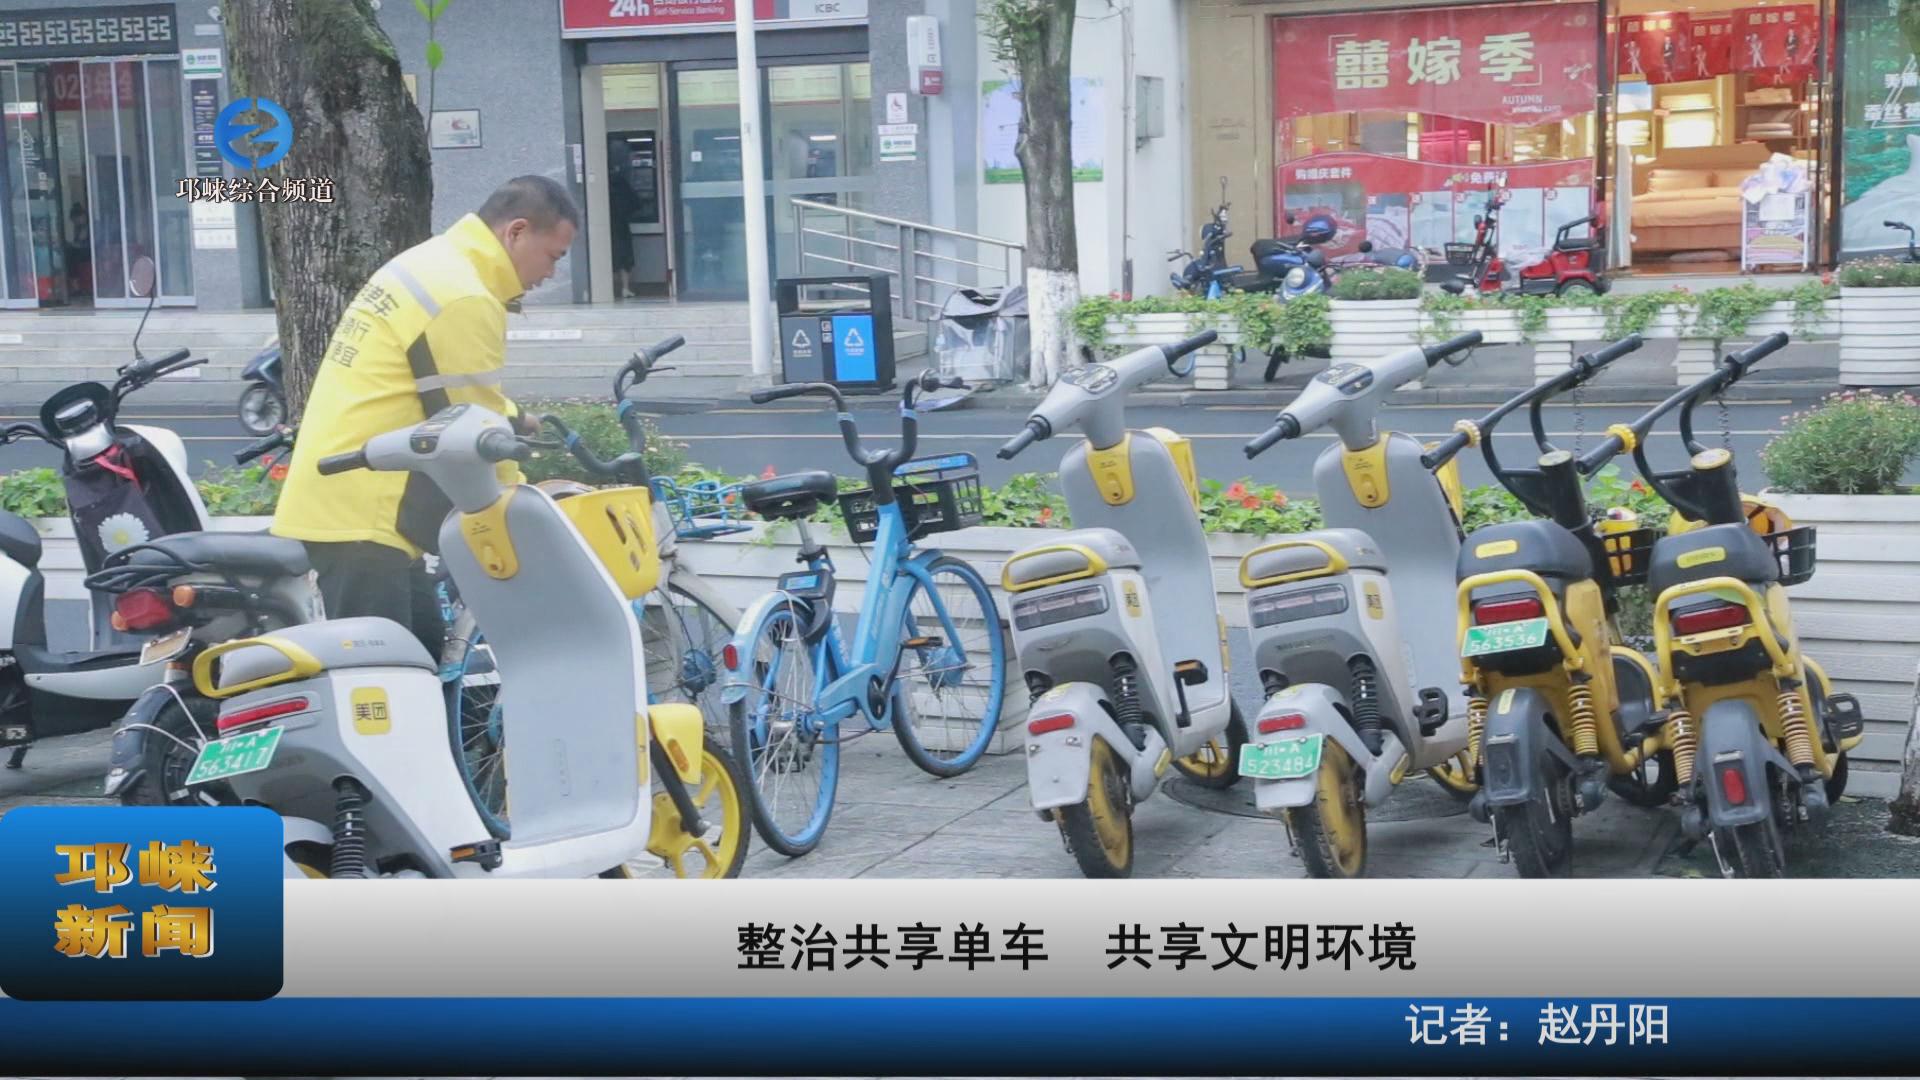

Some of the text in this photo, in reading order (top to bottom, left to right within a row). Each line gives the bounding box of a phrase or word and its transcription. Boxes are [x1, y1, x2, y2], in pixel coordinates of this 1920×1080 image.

[609, 0, 649, 17] 24h
[1502, 95, 1543, 105] AUTUMN
[1470, 634, 1538, 653] 563536
[355, 702, 388, 721] 美团
[196, 747, 269, 778] 563417
[1247, 754, 1314, 775] 523484
